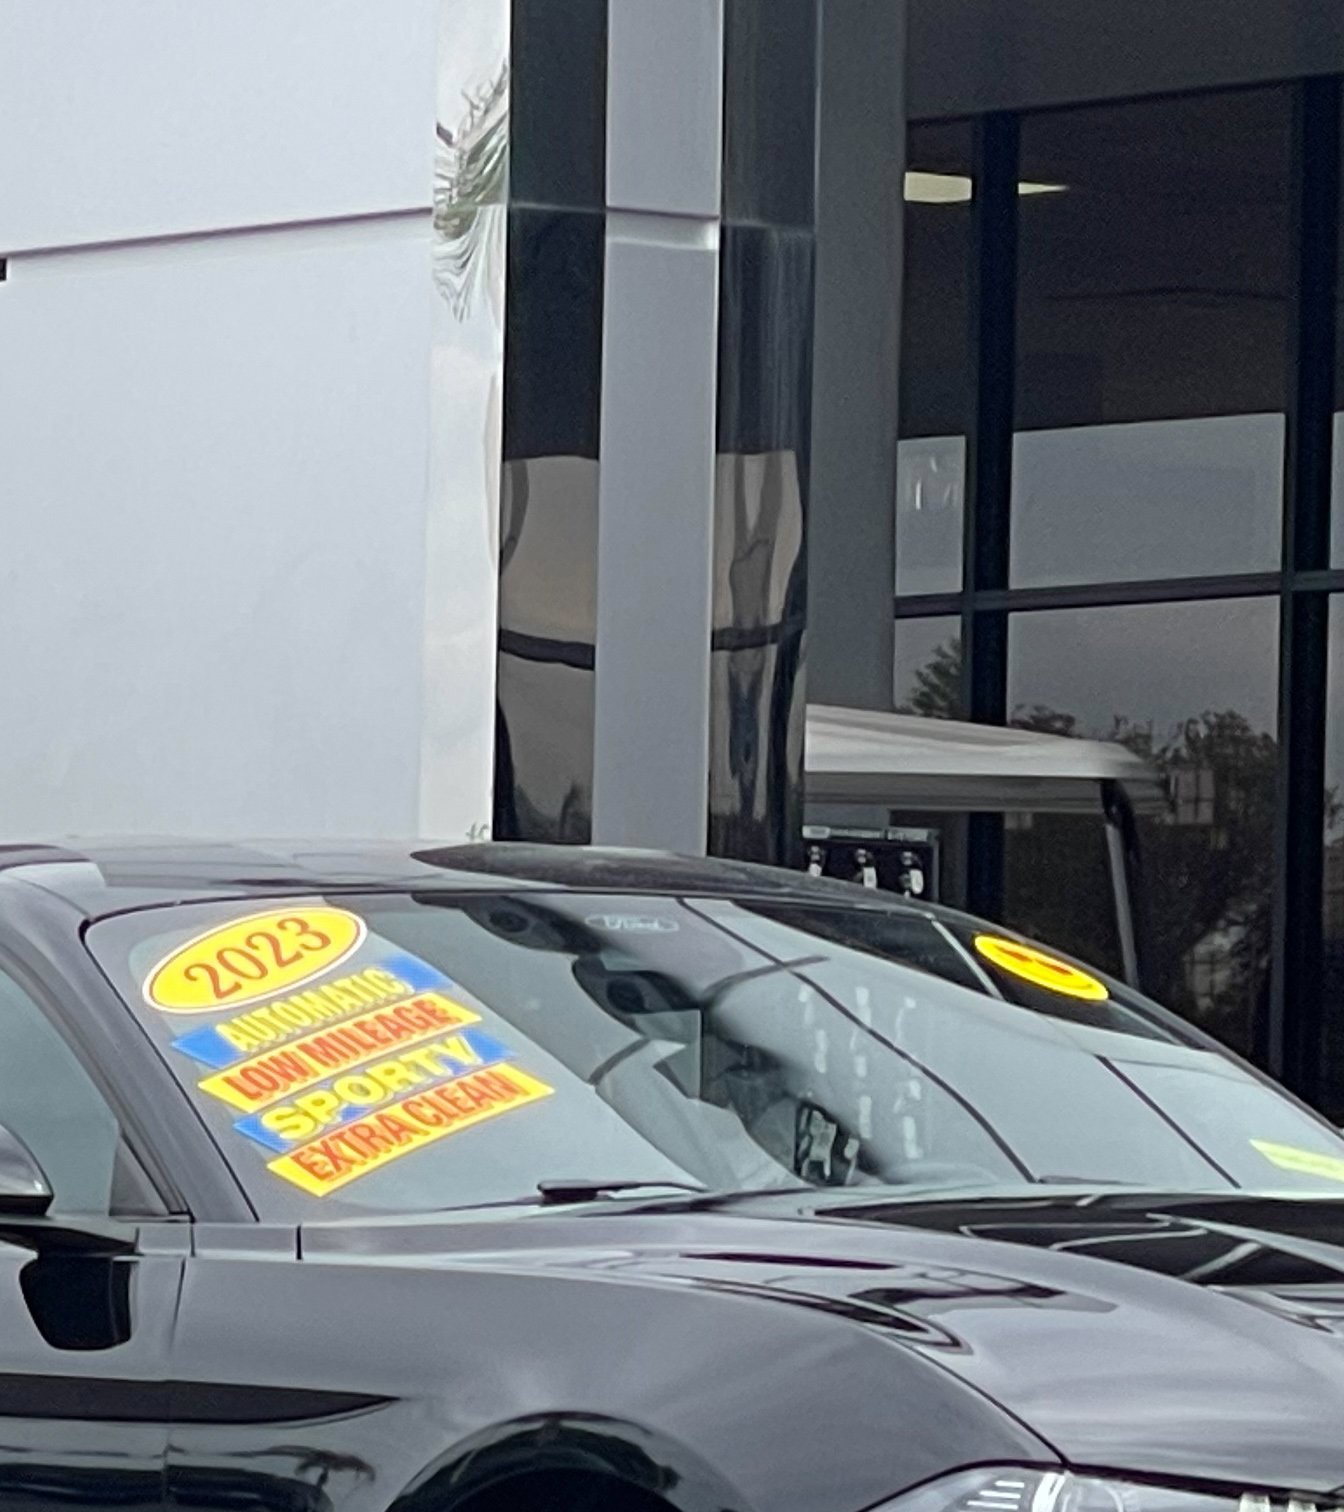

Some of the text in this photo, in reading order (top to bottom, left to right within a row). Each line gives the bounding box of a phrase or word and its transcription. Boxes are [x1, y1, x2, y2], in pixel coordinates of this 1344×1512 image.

[183, 917, 332, 999] 2023
[215, 966, 415, 1053] AUTOMATIC
[223, 999, 453, 1103] LOW MILEAGE
[261, 1036, 485, 1140] SPORTY
[290, 1069, 522, 1182] EXTRA CLEAN
